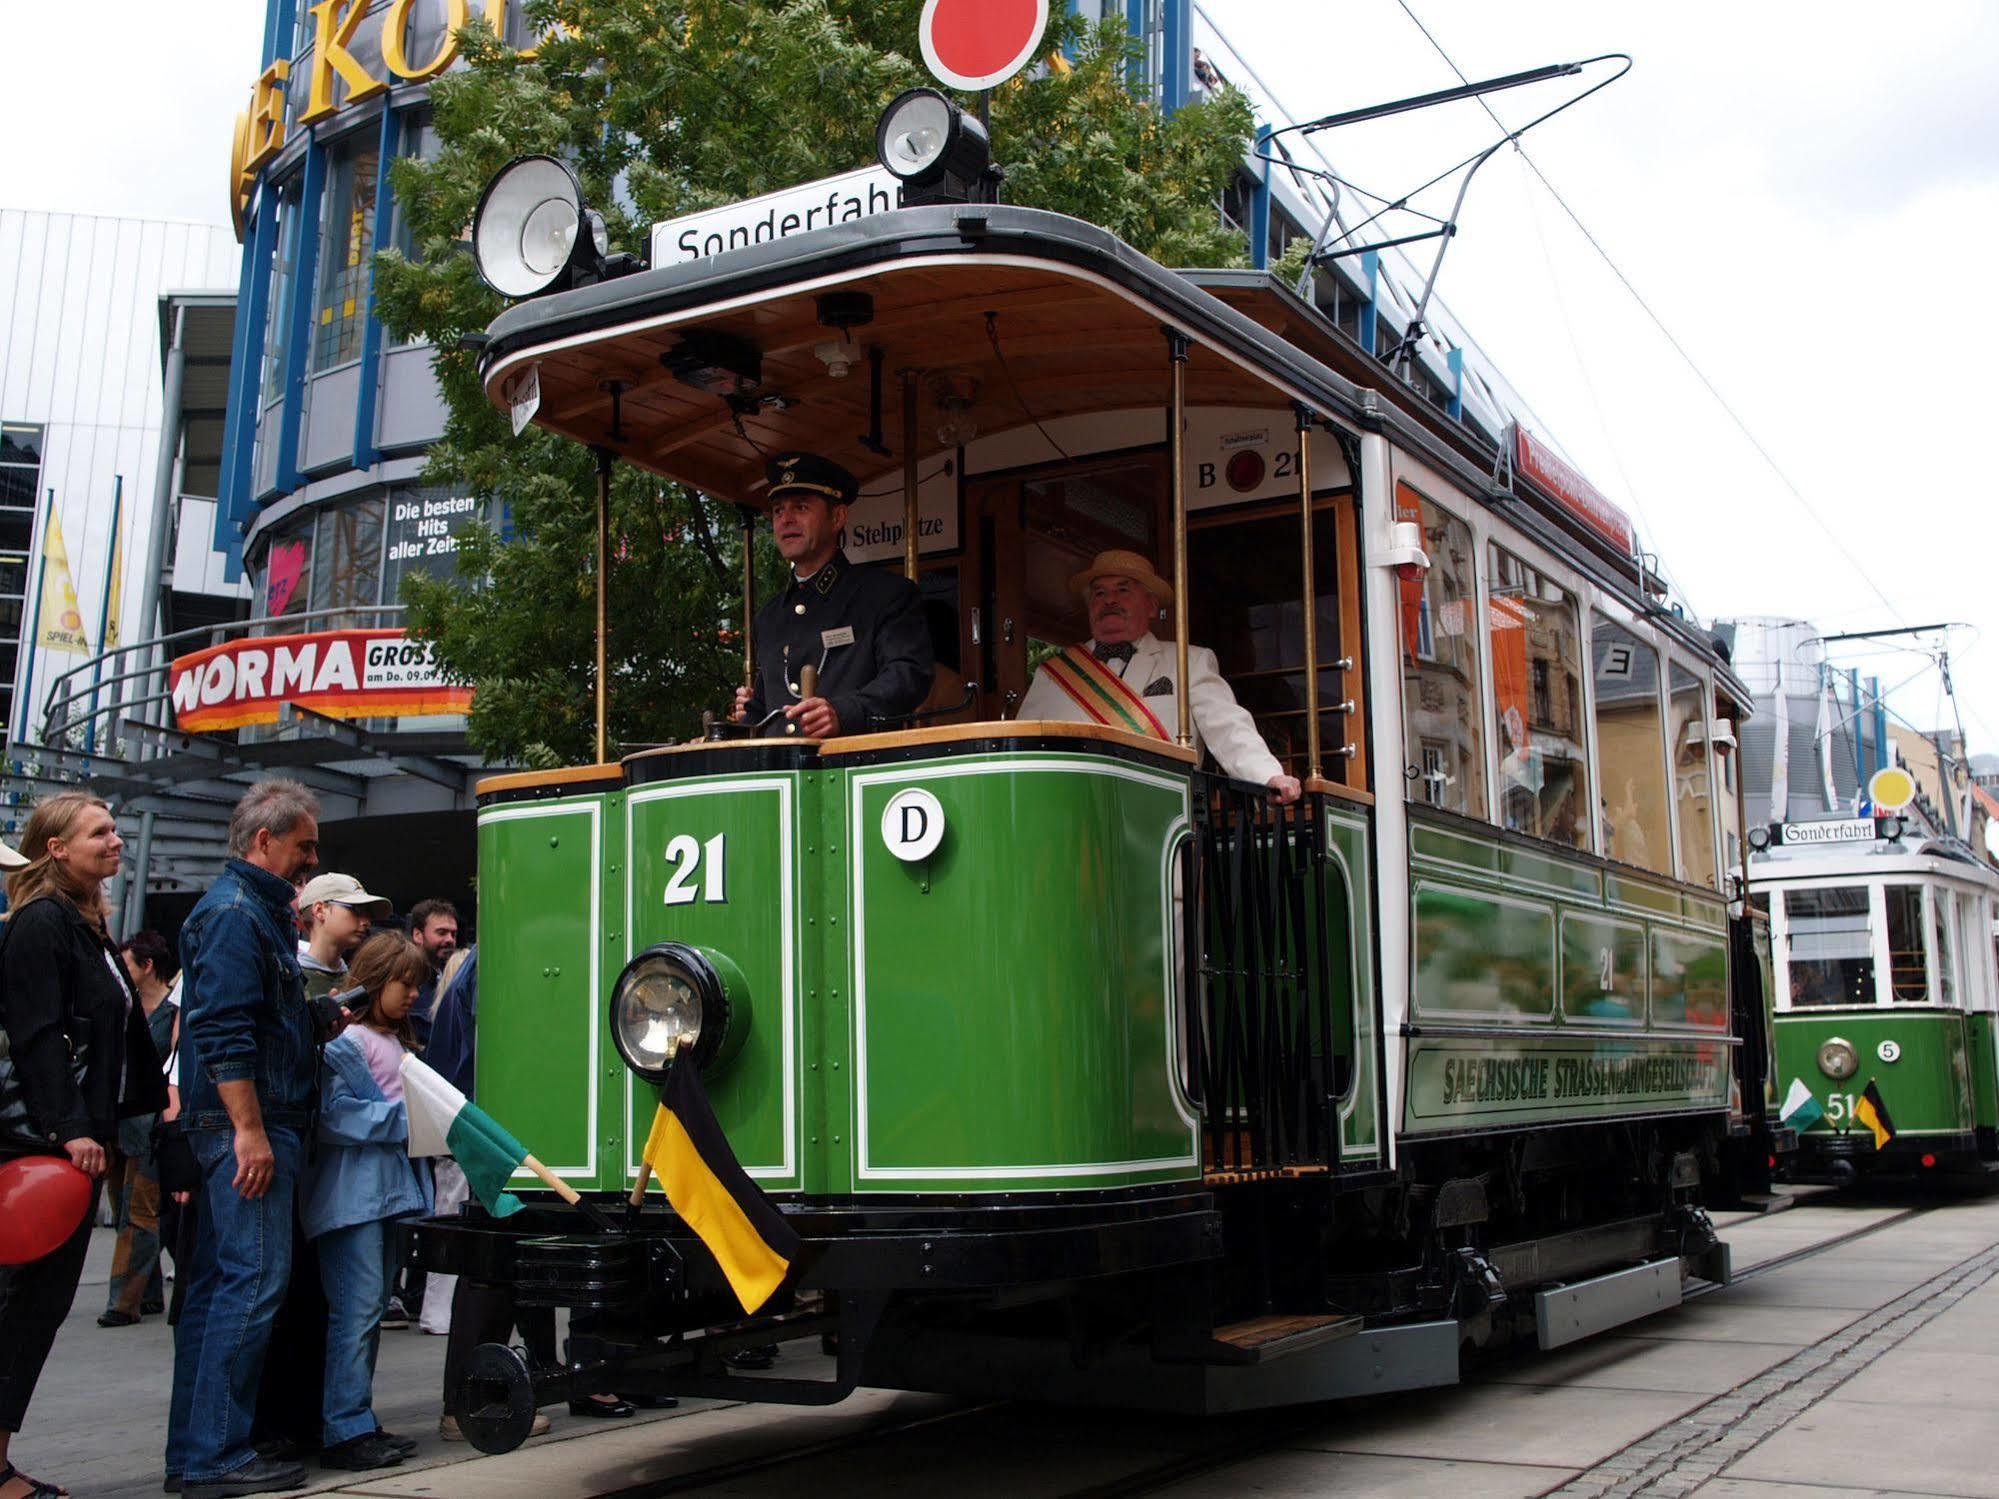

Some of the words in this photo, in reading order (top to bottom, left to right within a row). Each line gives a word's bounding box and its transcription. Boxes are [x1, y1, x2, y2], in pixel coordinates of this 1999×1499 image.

[1199, 463, 1216, 488] B
[1274, 452, 1301, 478] 21
[395, 502, 420, 521] Die
[423, 497, 474, 517] besten
[417, 519, 448, 537] Hits
[388, 541, 424, 560] aller
[172, 640, 358, 714] NORMA
[367, 674, 383, 682] am
[386, 671, 403, 682] Do.
[900, 805, 928, 843] D
[1785, 823, 1873, 842] Sonderfahrt
[663, 832, 729, 906] 21
[1599, 946, 1614, 992] 21
[1882, 1043, 1894, 1058] 5
[1442, 1057, 1549, 1105] SAECHSISCHE
[1827, 1093, 1856, 1121] 51
